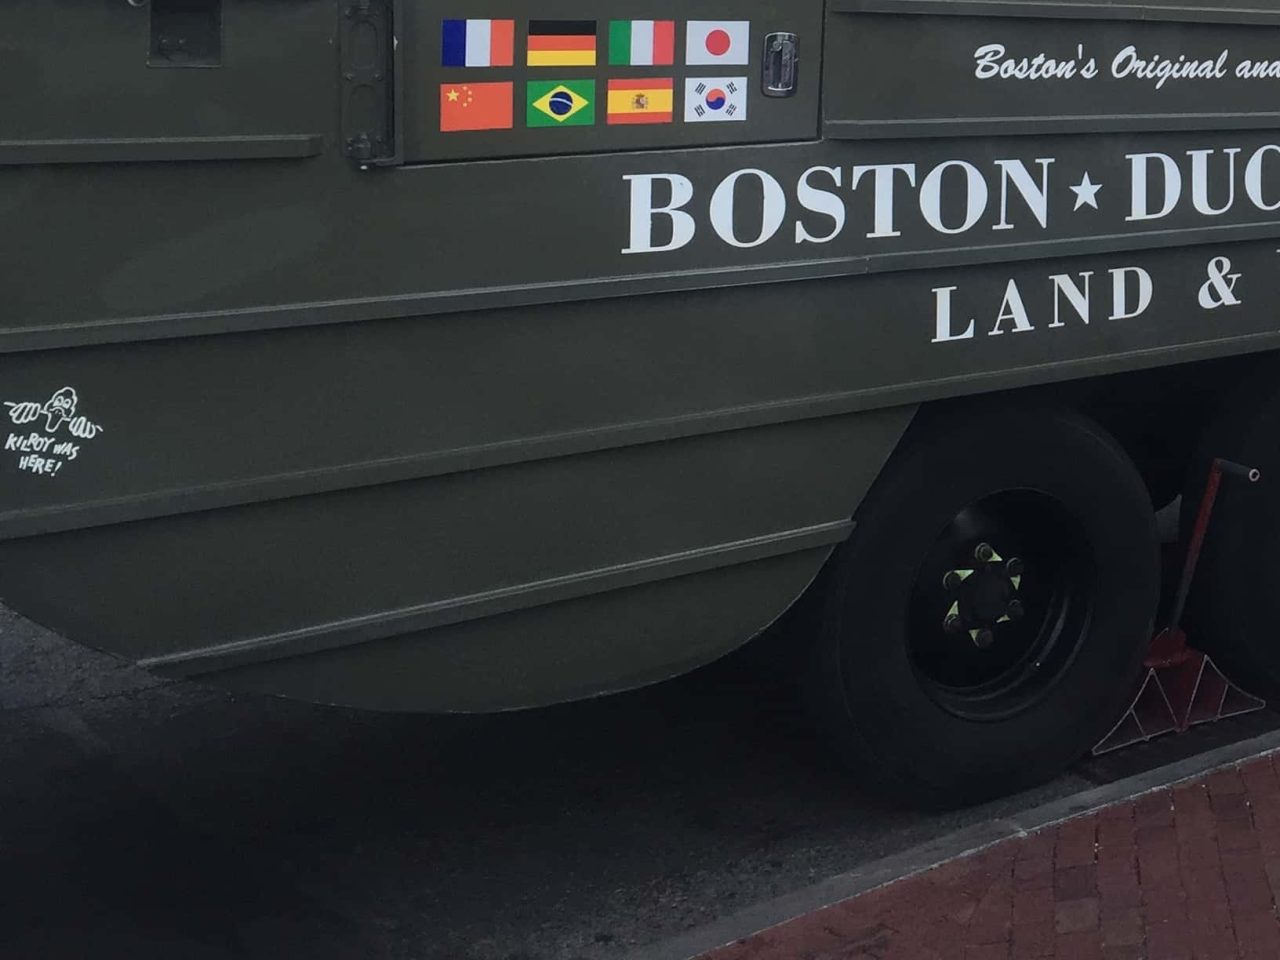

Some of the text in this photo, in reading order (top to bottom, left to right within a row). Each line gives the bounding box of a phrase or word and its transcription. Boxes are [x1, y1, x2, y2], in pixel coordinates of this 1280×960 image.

[974, 43, 1098, 80] Boston's
[1111, 44, 1229, 90] Original
[620, 157, 1055, 255] BOSTON
[930, 266, 1154, 343] LAND
[1198, 256, 1242, 309] &
[4, 432, 80, 460] KILROY WAS
[18, 454, 62, 477] HERE!
